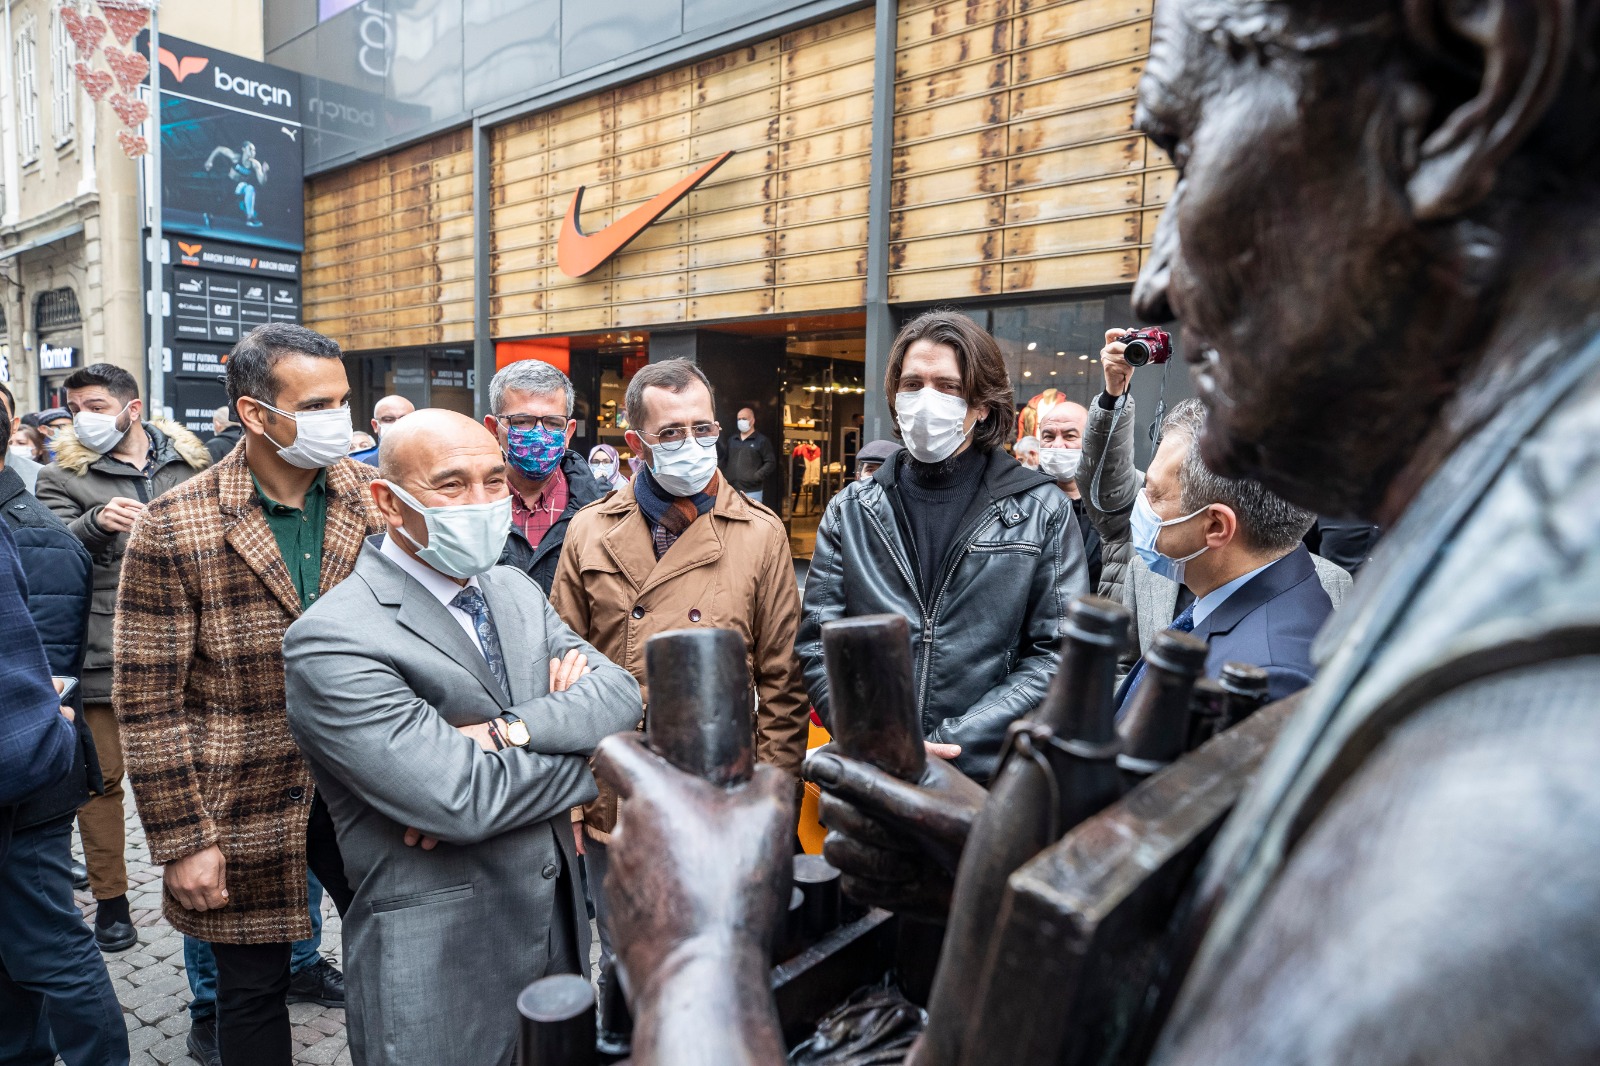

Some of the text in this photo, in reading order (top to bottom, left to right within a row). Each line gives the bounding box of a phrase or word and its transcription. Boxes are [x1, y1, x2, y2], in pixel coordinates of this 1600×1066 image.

[214, 66, 291, 107] barçın
[214, 303, 232, 316] CAT
[182, 352, 196, 362] NIKE
